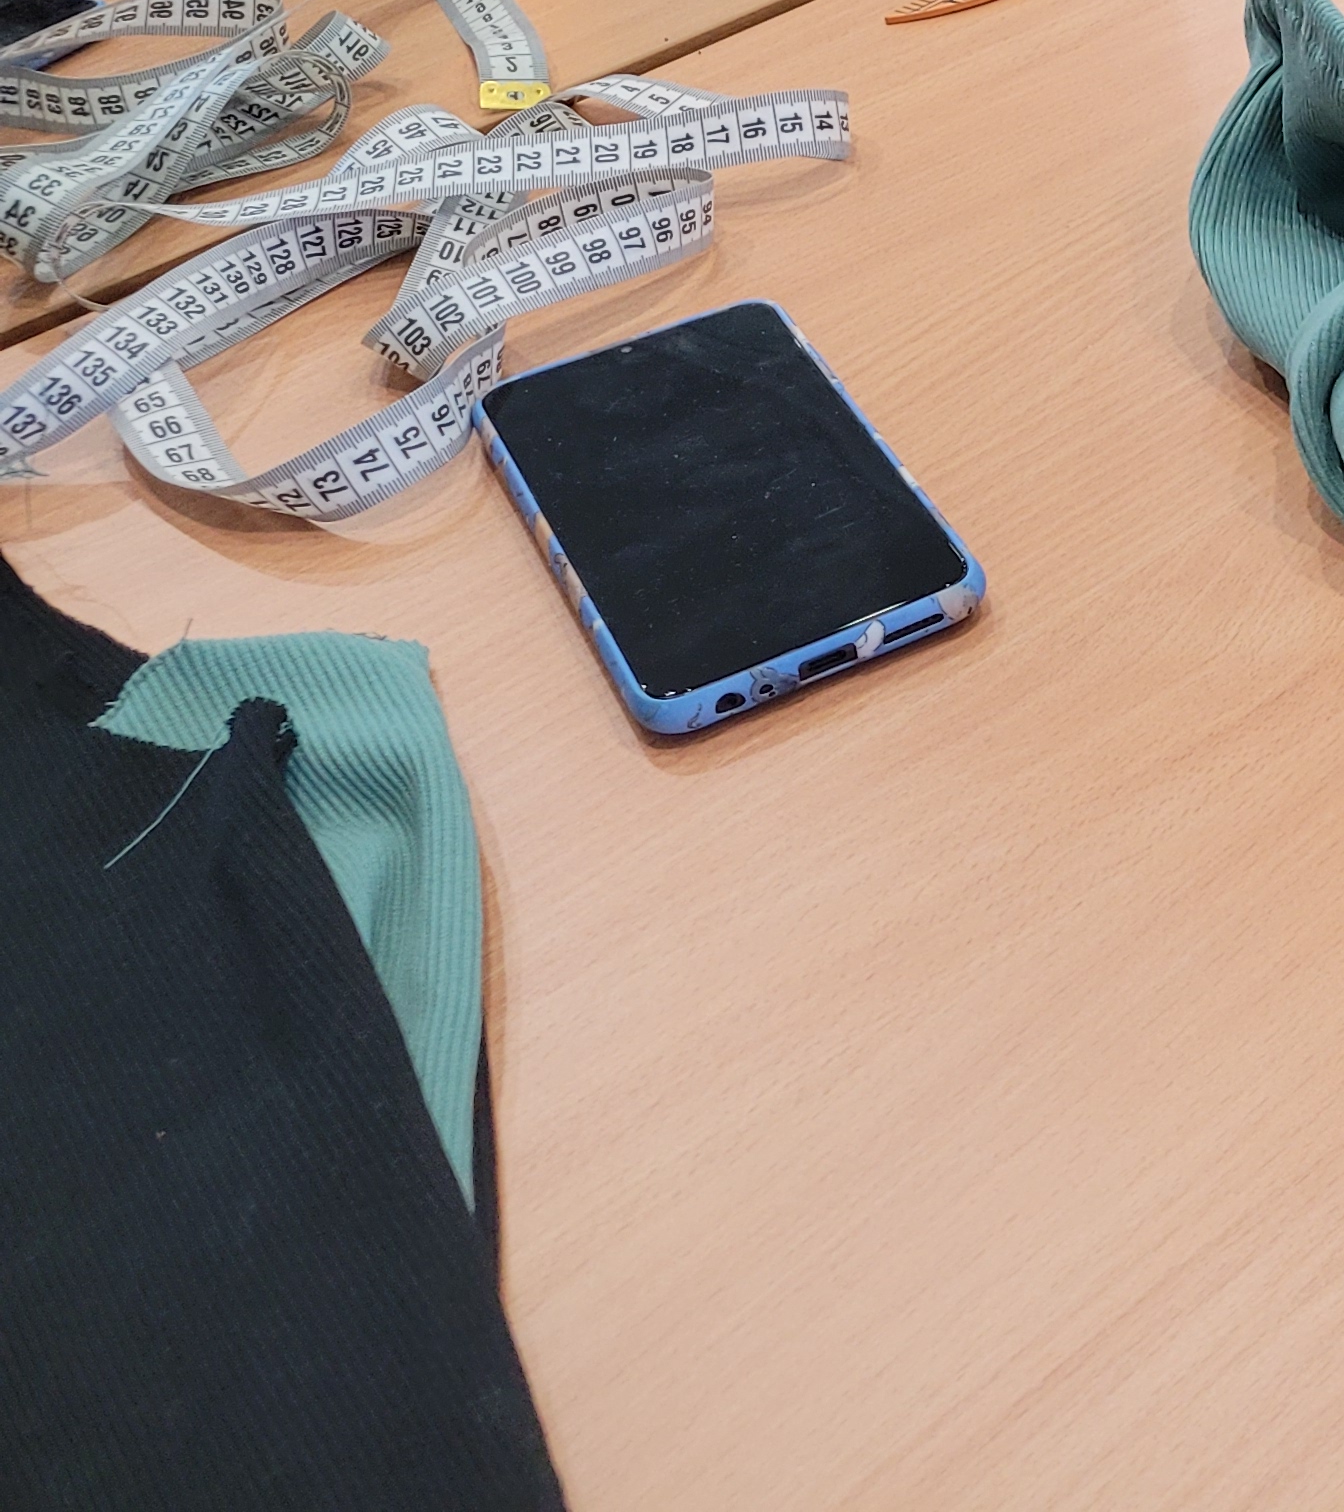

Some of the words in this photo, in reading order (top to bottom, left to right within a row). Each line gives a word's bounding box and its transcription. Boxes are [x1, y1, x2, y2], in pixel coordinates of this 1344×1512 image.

[323, 187, 347, 202] 27
[360, 176, 385, 195] 26
[398, 168, 424, 187] 25
[437, 159, 463, 179] 24
[477, 155, 502, 175] 23
[517, 151, 541, 172] 22
[556, 146, 581, 165] 21
[595, 143, 619, 163] 20
[633, 140, 657, 159] 19
[671, 133, 694, 154] 18
[706, 124, 730, 143] 17
[742, 117, 767, 138] 16
[779, 112, 803, 134] 15
[814, 111, 834, 131] 14
[365, 139, 394, 159] 45
[399, 122, 427, 140] 46
[337, 219, 363, 249] 126
[376, 218, 403, 239] 125
[619, 227, 646, 249] 97
[652, 217, 674, 243] 96
[680, 209, 697, 235] 95
[267, 238, 296, 275] 128
[300, 225, 328, 259] 127
[582, 239, 612, 264] 98
[220, 259, 250, 294] 130
[242, 250, 268, 285] 129
[505, 261, 542, 295] 100
[545, 251, 576, 276] 99
[167, 288, 206, 320] 132
[196, 272, 229, 304] 131
[466, 276, 505, 309] 101
[138, 306, 178, 335] 133
[429, 294, 465, 333] 102
[106, 326, 150, 359] 134
[396, 317, 432, 356] 103
[73, 350, 118, 387] 135
[477, 359, 491, 390] 79
[39, 377, 82, 415] 136
[134, 391, 166, 413] 65
[3, 406, 47, 440] 137
[149, 416, 182, 438] 66
[431, 403, 456, 437] 76
[165, 443, 195, 463] 67
[394, 426, 428, 460] 75
[181, 468, 215, 482] 68
[353, 448, 390, 482] 74
[276, 488, 311, 512] 72
[313, 470, 348, 502] 73
